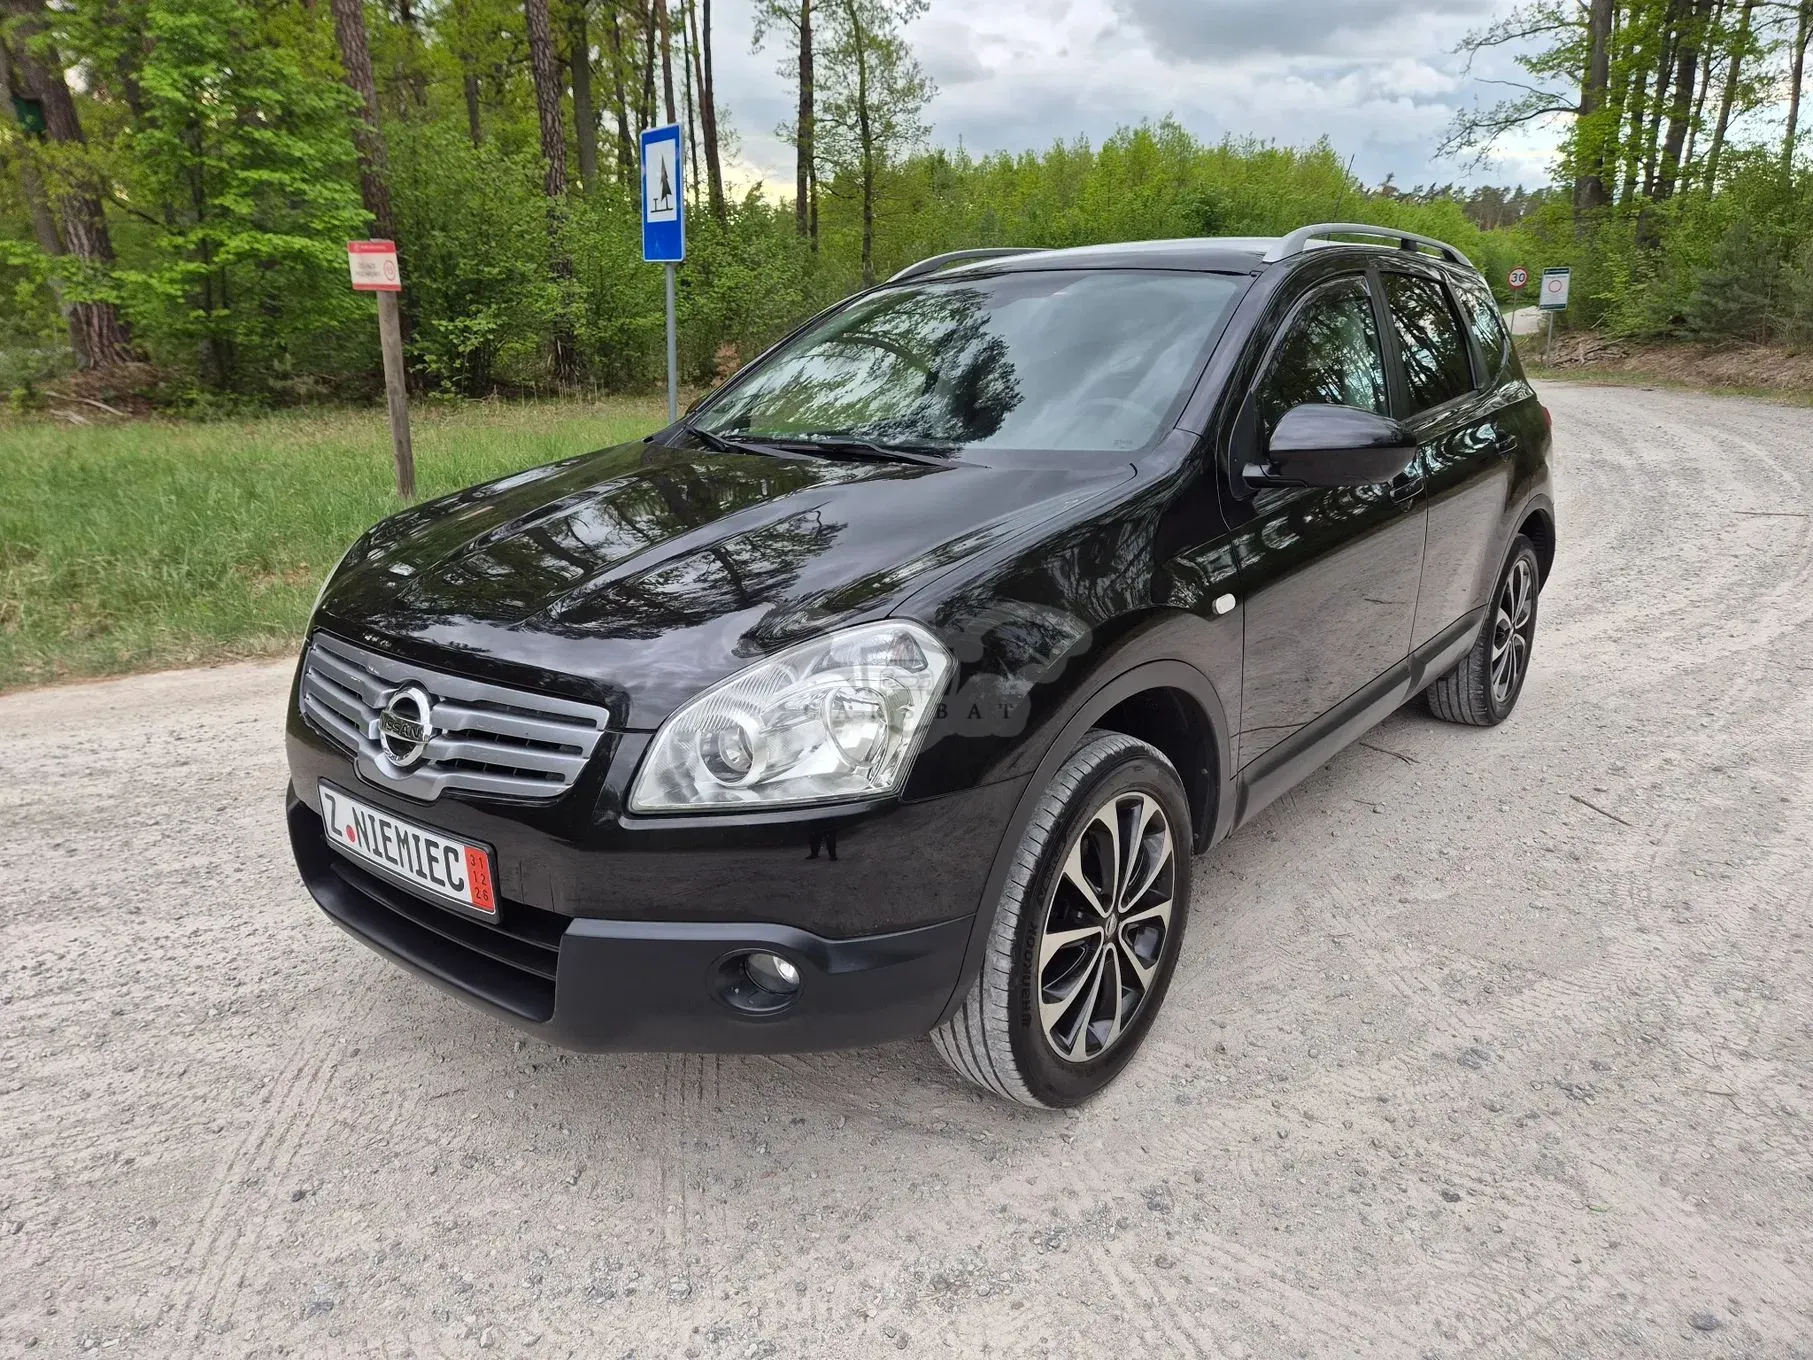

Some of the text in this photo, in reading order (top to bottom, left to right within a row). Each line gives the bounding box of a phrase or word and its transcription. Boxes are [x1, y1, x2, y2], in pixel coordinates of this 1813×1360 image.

[1511, 272, 1526, 283] 30
[325, 792, 465, 892] Z NIEMIEC
[470, 854, 484, 870] 31
[473, 870, 487, 886] 12
